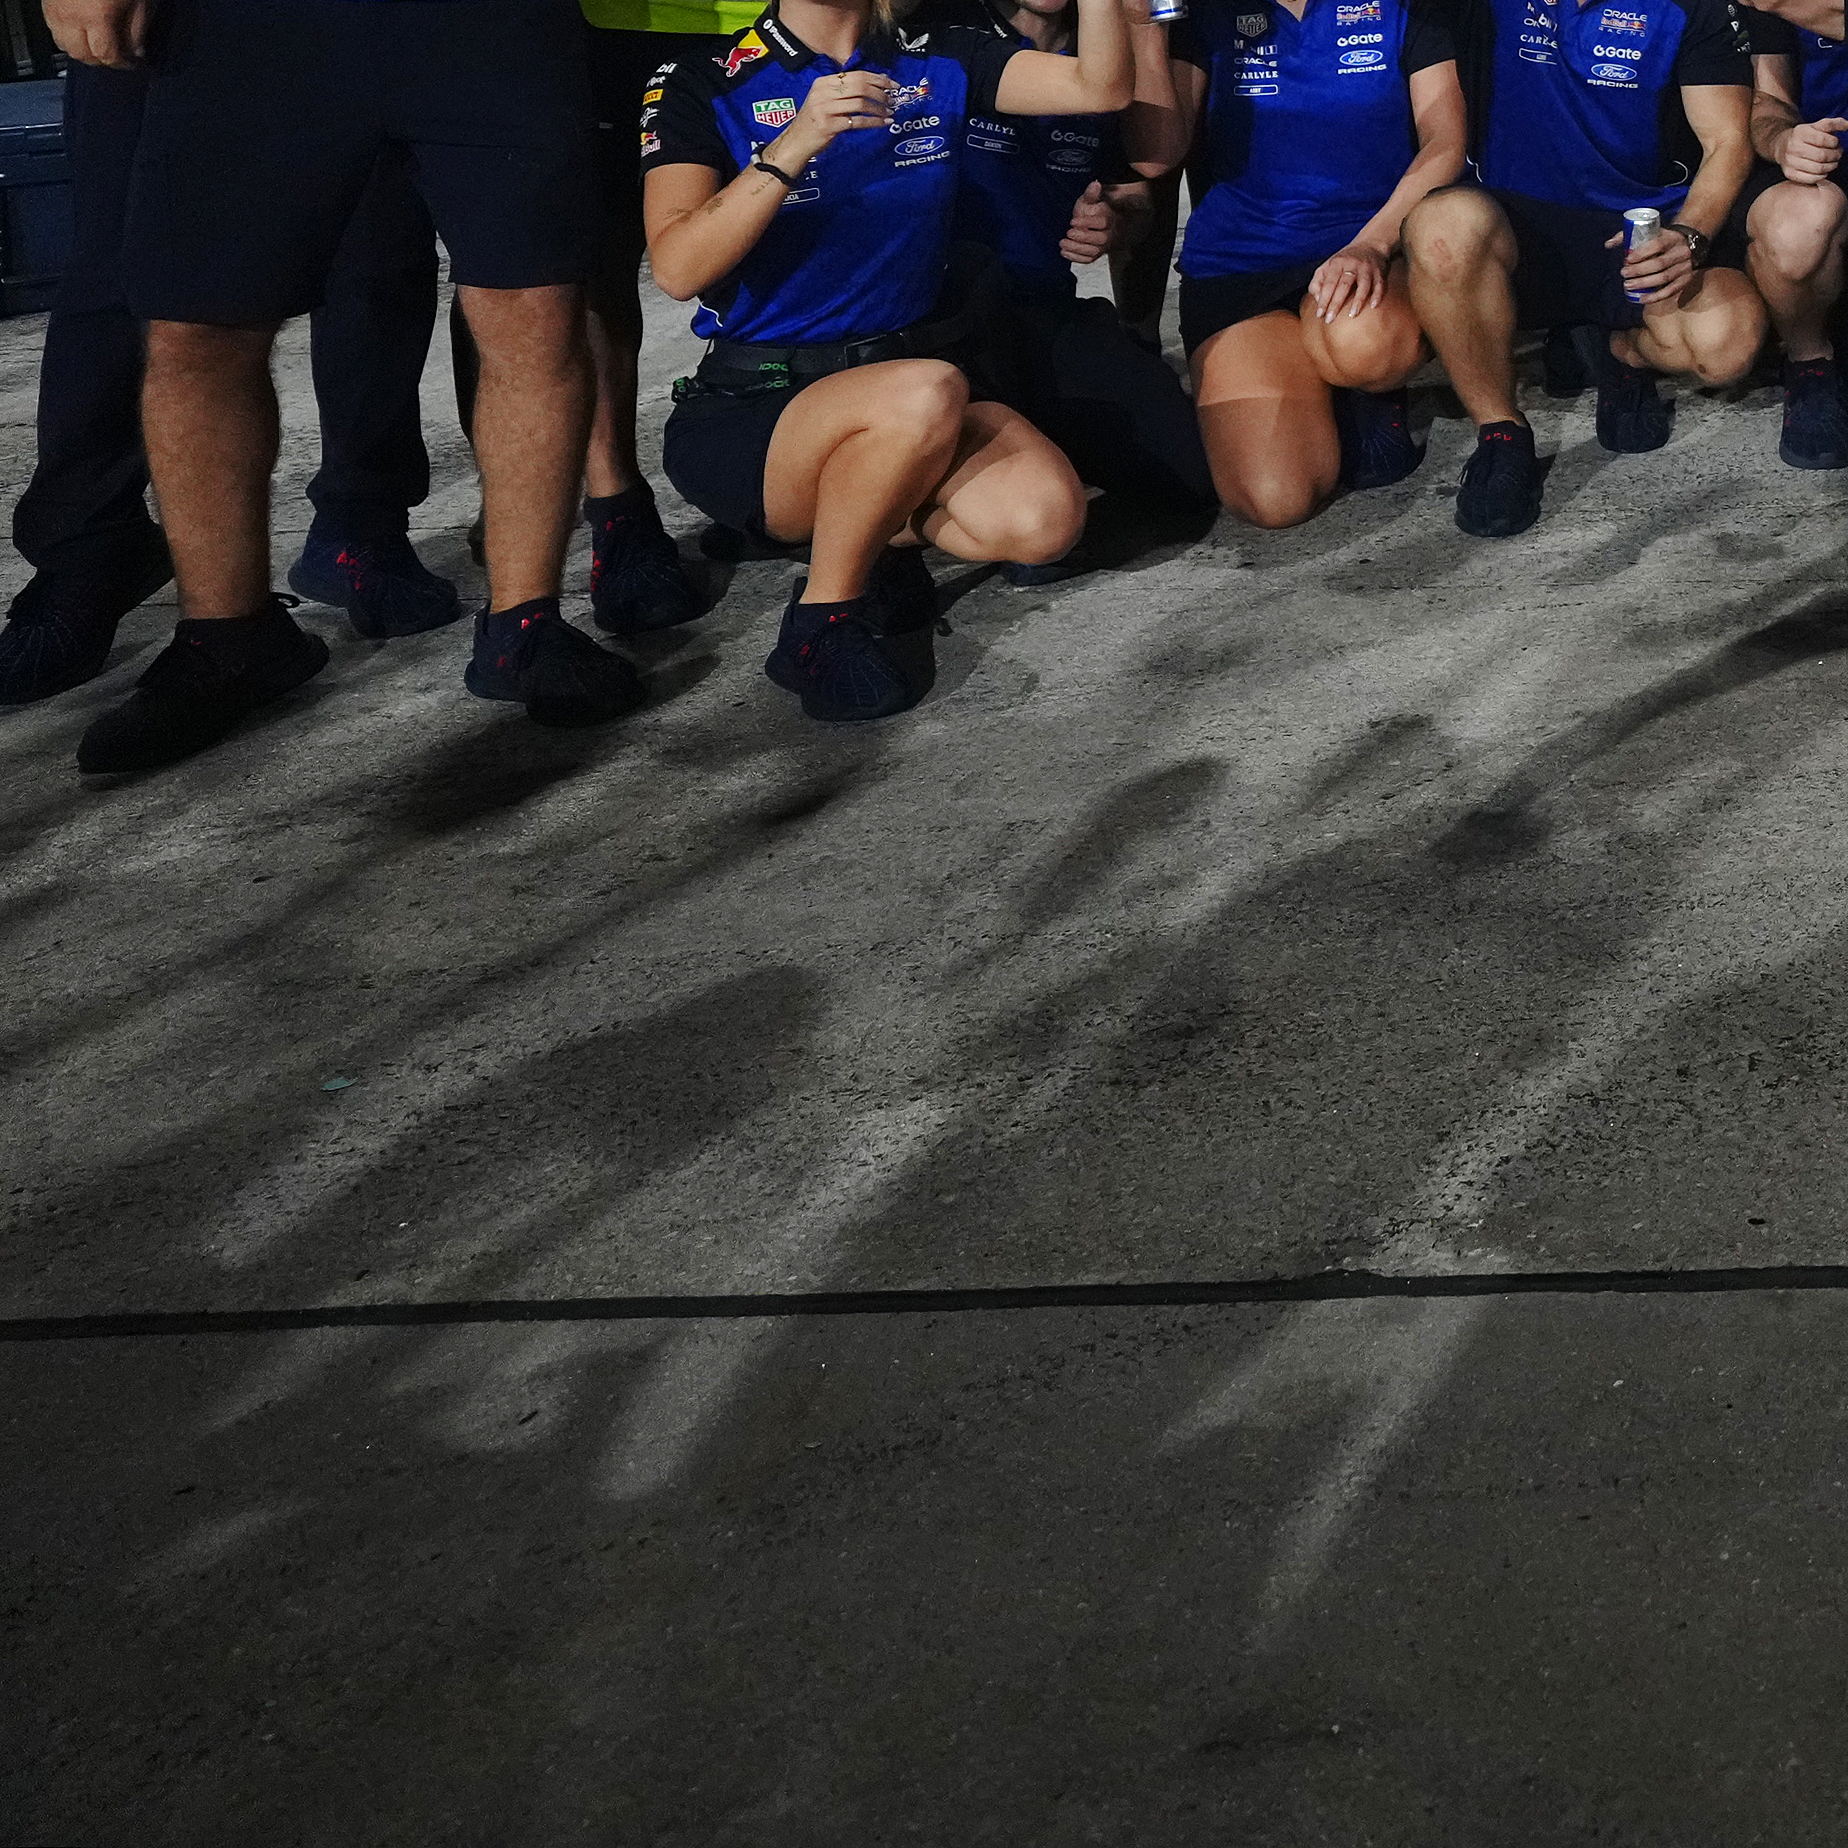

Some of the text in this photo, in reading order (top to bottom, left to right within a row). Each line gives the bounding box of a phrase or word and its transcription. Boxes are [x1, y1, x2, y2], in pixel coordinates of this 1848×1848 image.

[1336, 0, 1381, 13] ORACLE
[1602, 9, 1648, 22] ORACLE
[1349, 33, 1384, 46] Gate
[1605, 46, 1642, 61] Gate
[1233, 70, 1280, 80] CARLYLE
[1337, 64, 1388, 75] RACING
[1586, 78, 1639, 89] RACING
[756, 100, 792, 113] TAG
[756, 111, 797, 127] HEUER
[903, 114, 940, 131] Gate
[894, 150, 951, 168] RACING
